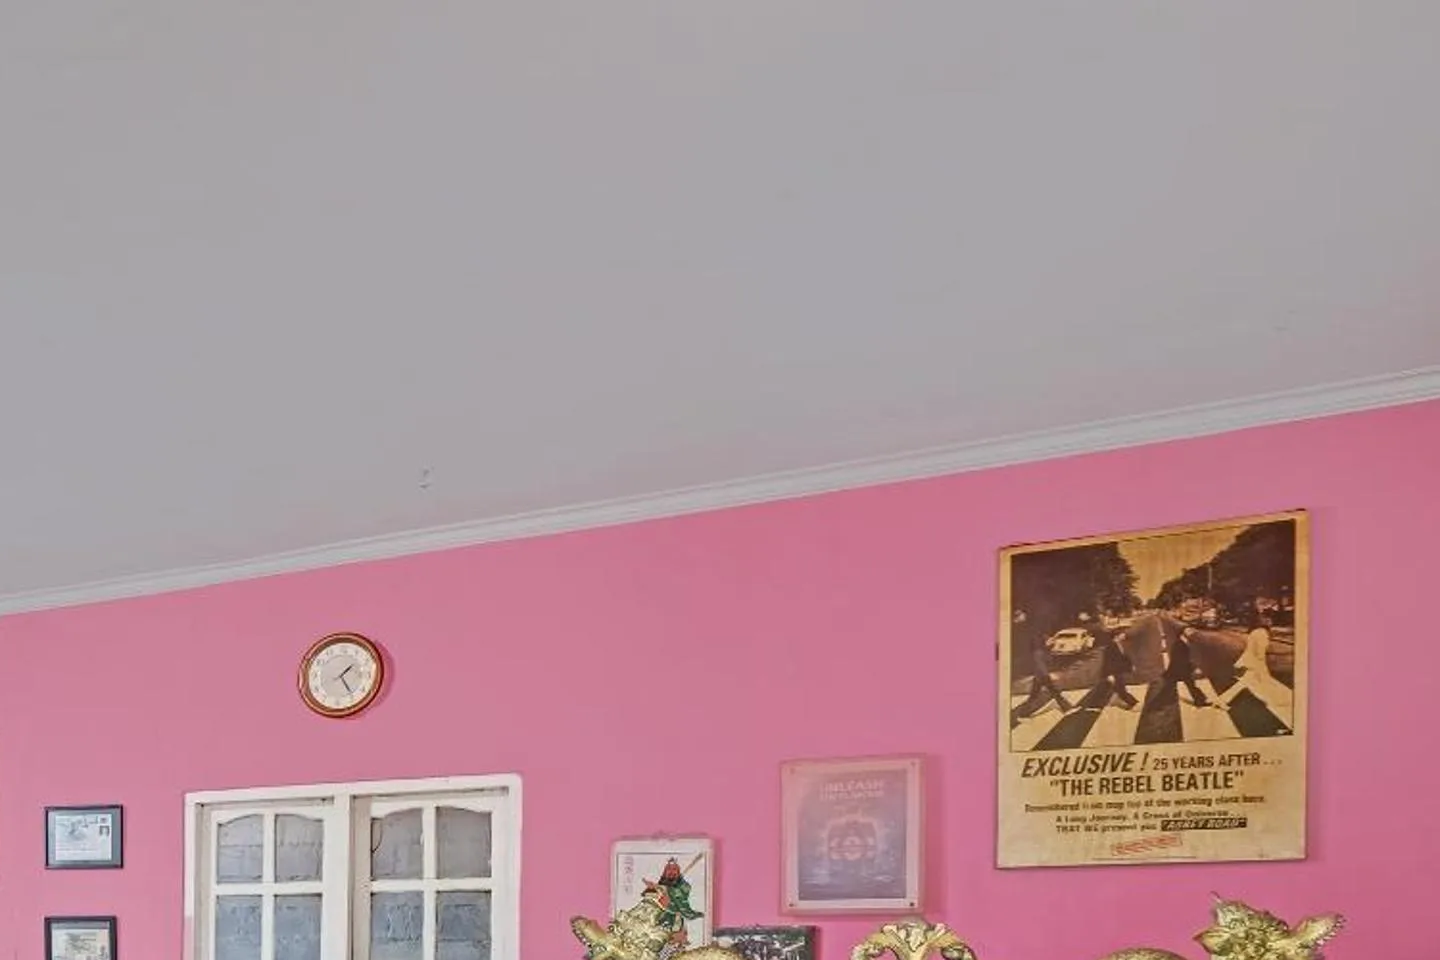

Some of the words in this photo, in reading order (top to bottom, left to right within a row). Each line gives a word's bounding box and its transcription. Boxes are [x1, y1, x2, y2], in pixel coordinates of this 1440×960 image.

[1021, 752, 1136, 778] EXCLUSIVE
[1172, 755, 1215, 770] YEARS
[1099, 774, 1156, 794] REBEL
